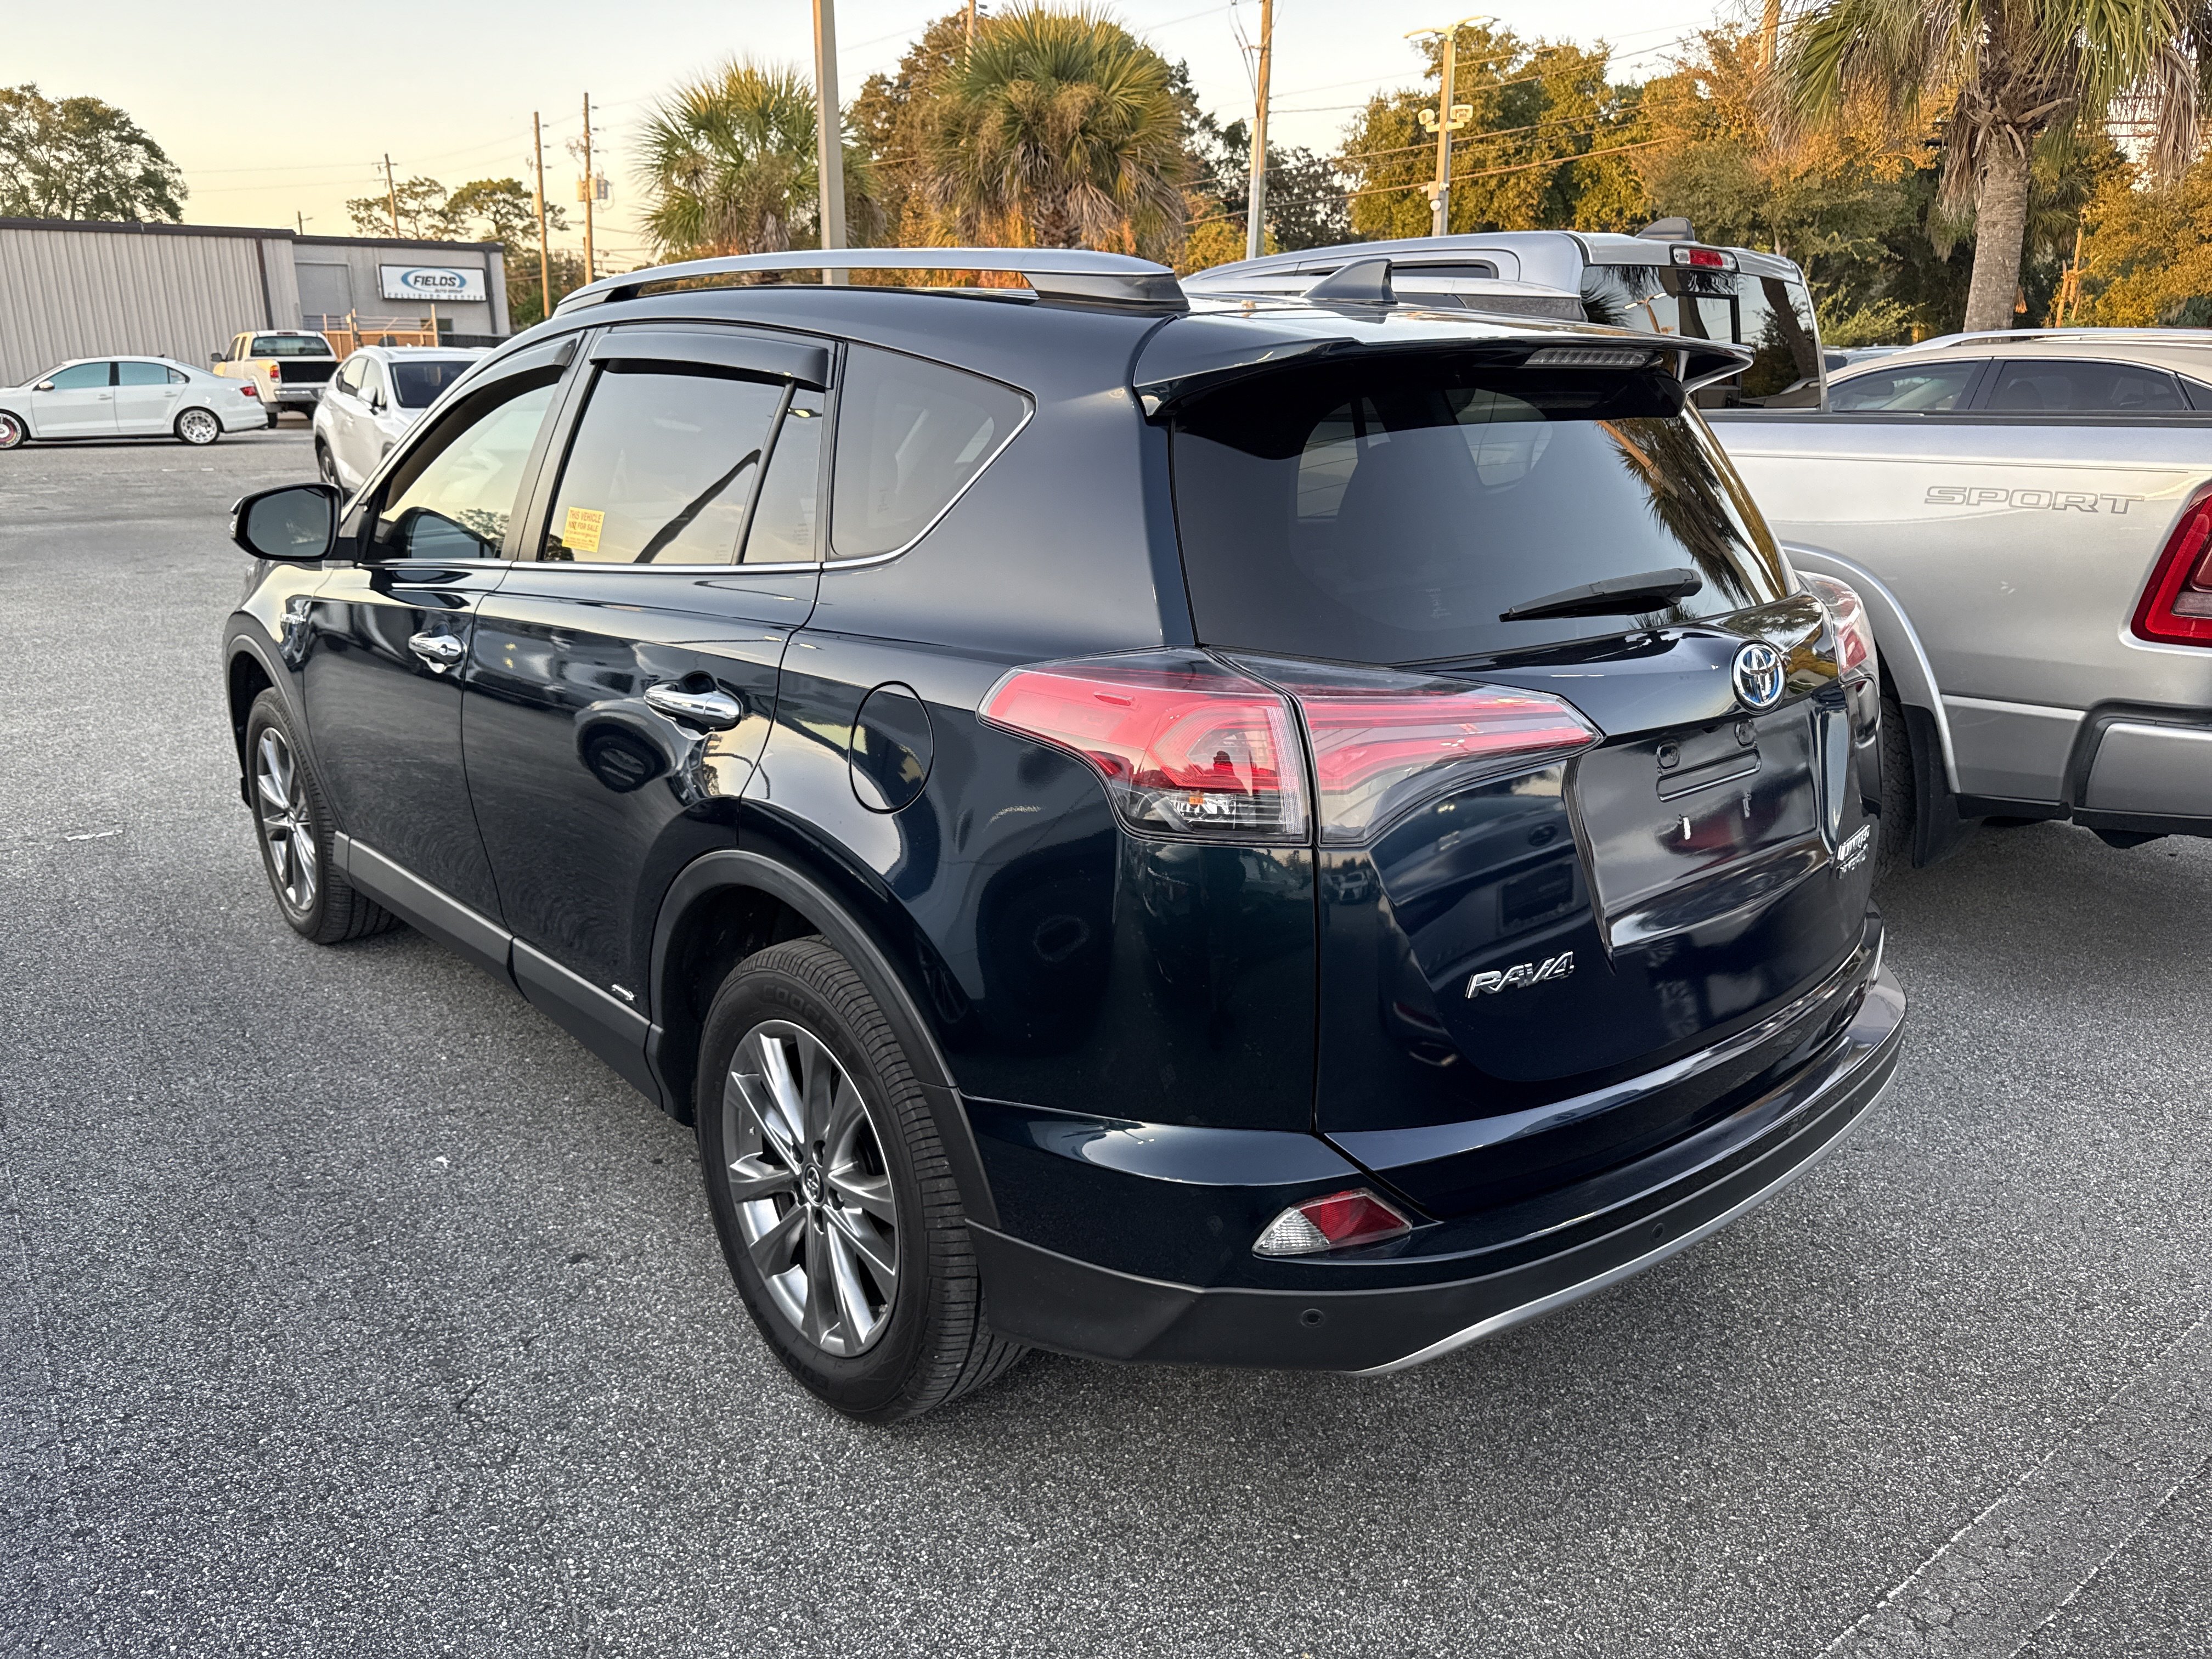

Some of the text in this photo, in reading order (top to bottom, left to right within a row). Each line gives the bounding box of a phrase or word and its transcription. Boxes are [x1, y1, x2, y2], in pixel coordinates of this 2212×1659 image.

[413, 275, 457, 287] FIELDS
[1925, 486, 2145, 515] SPORT
[569, 510, 602, 523] THIS VEHICLE
[577, 522, 586, 531] FOR
[587, 523, 599, 533] SALE
[1465, 951, 1575, 999] RAV4
